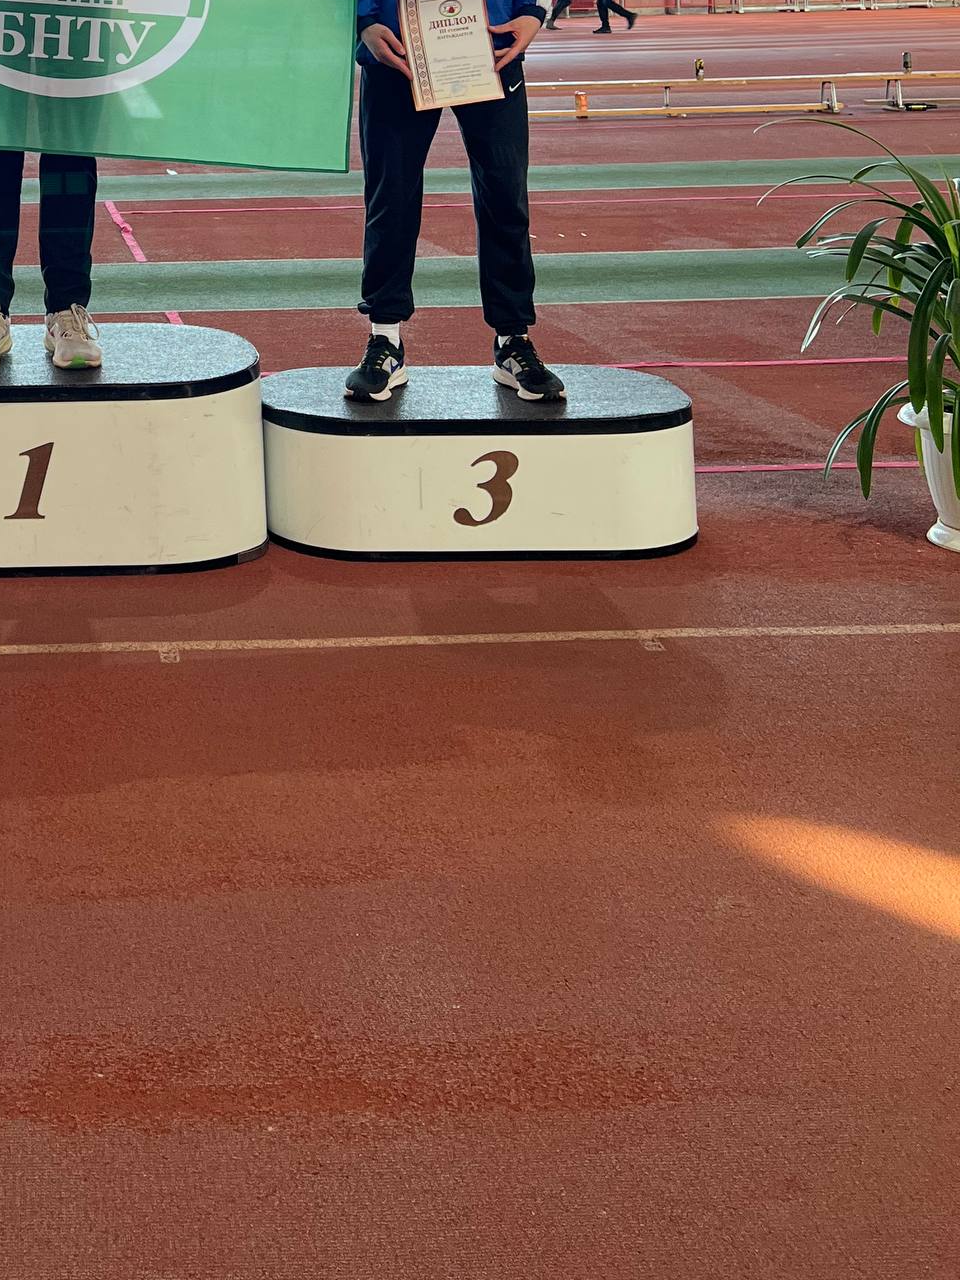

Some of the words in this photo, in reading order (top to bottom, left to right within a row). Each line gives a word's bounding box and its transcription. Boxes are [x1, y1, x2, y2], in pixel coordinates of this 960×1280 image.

[429, 14, 478, 31] ДИПЛОМ
[3, 441, 55, 520] 1
[453, 450, 519, 526] 3
